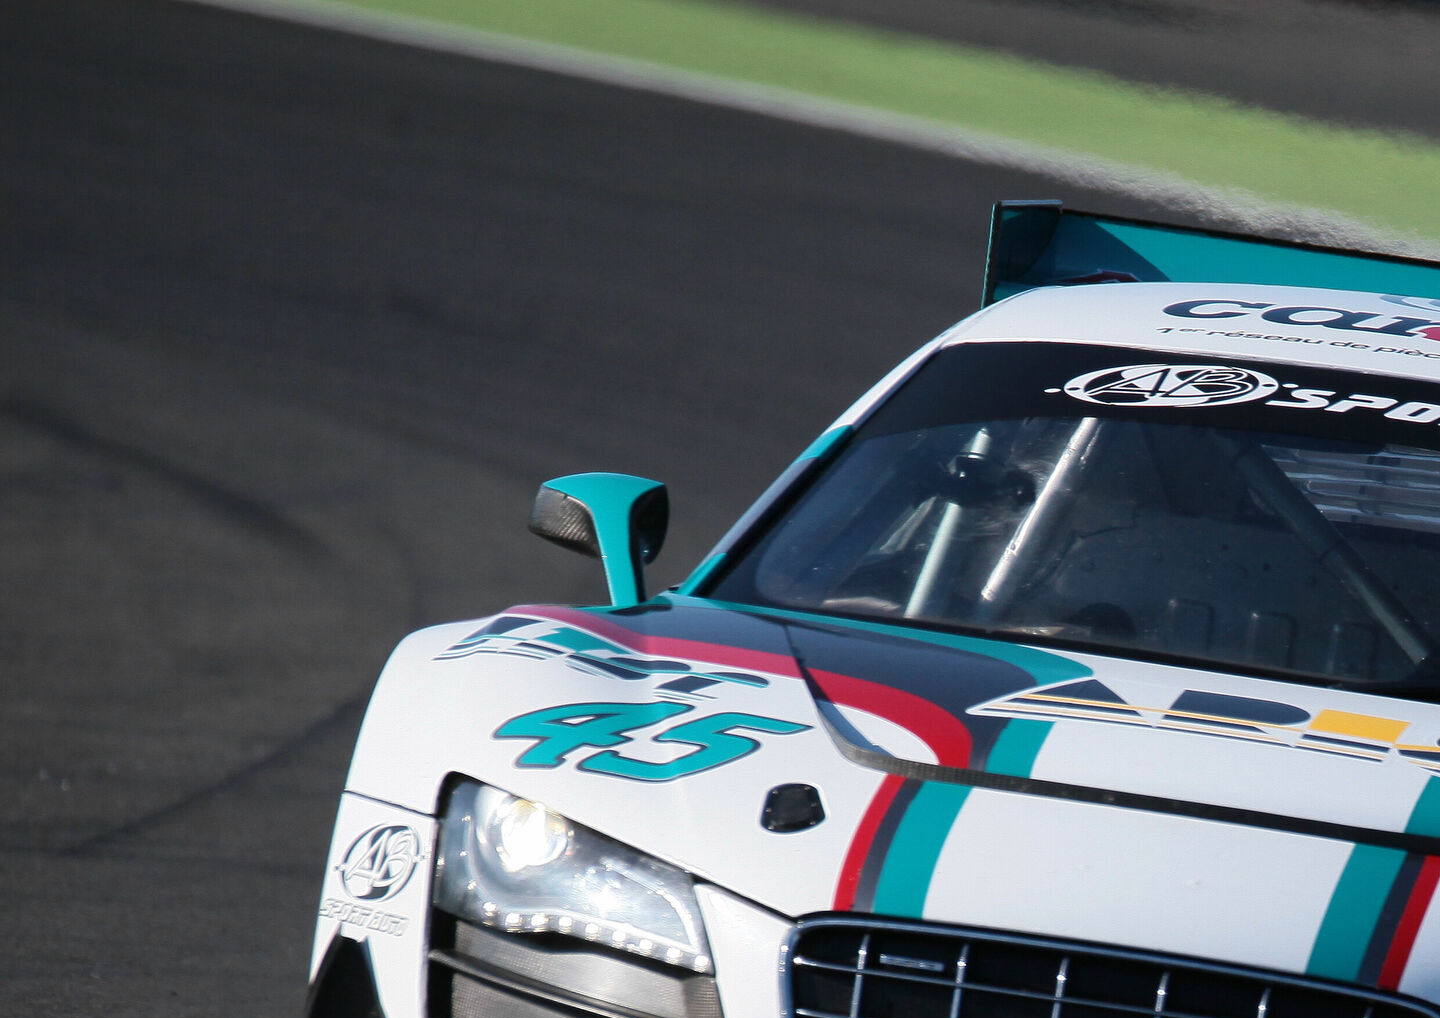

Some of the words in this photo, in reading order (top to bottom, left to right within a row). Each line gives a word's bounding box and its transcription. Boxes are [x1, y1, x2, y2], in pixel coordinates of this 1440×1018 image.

[1206, 329, 1323, 345] réseau
[1330, 341, 1371, 350] de
[493, 700, 814, 784] 45
